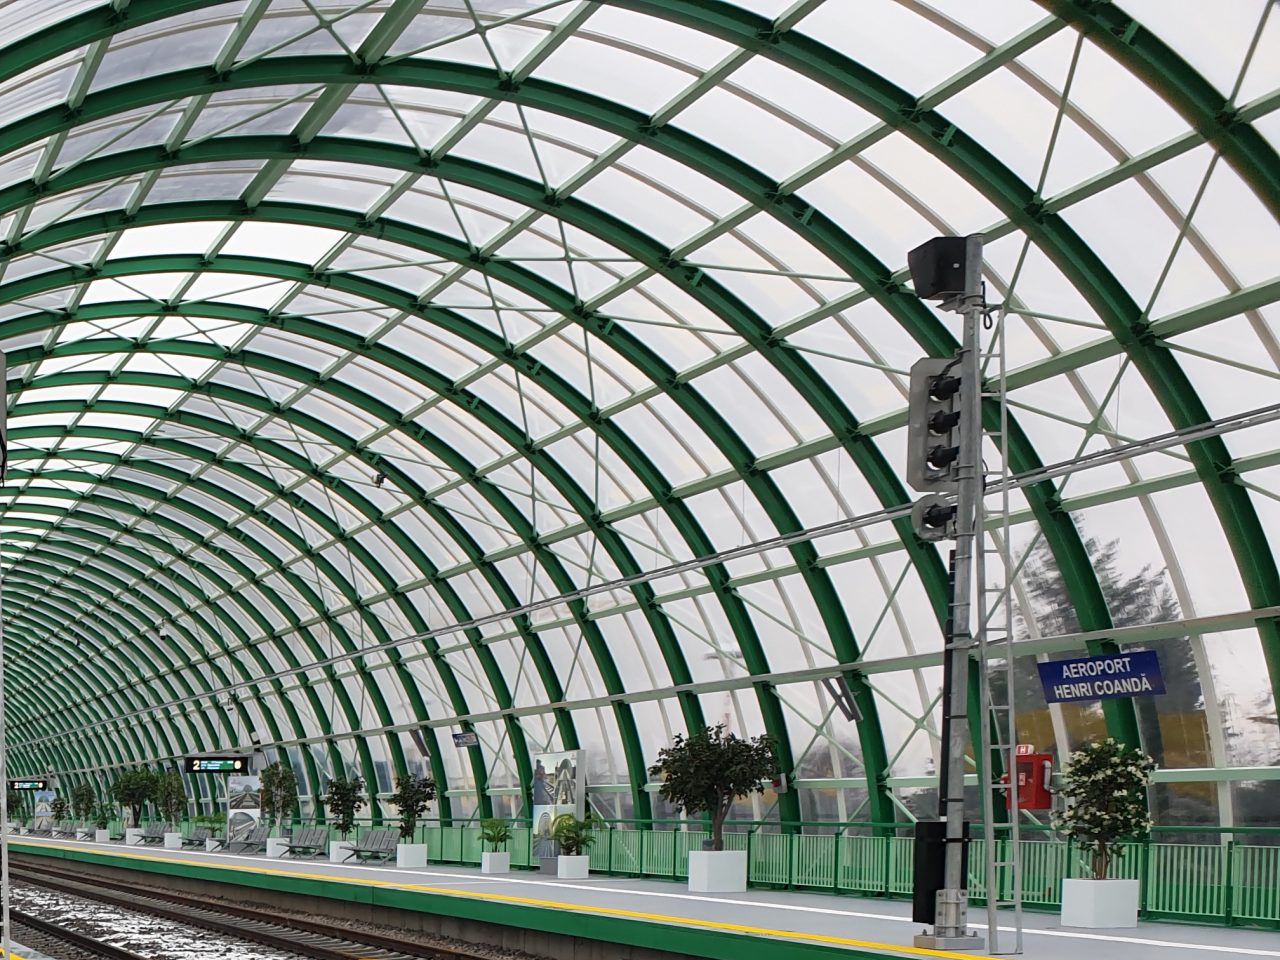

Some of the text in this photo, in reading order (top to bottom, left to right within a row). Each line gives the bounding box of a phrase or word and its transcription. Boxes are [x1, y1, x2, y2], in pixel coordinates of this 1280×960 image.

[1062, 657, 1131, 679] AEROPORT
[1053, 673, 1152, 699] HENRI COANDĂ
[192, 760, 200, 770] 2
